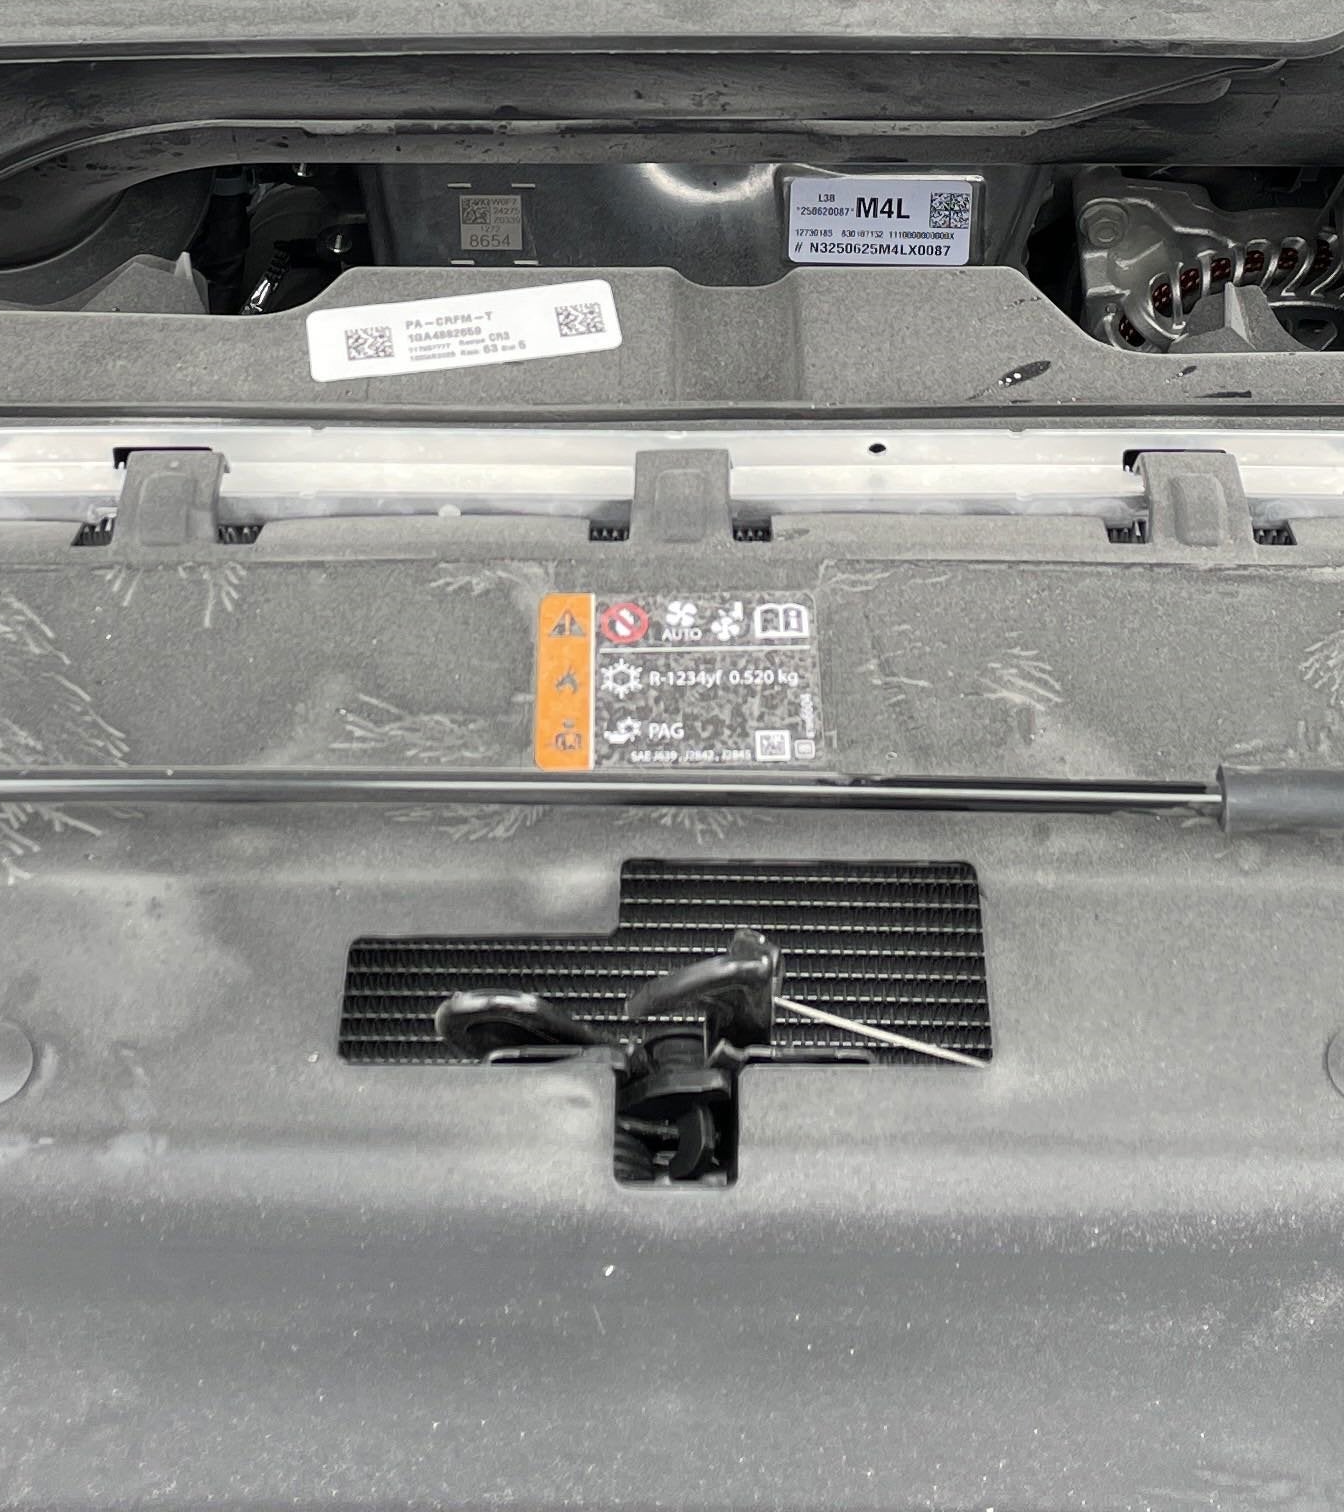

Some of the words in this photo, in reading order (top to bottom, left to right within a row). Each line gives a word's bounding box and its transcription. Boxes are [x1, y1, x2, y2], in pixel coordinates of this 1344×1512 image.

[856, 197, 910, 219] M4L
[470, 233, 511, 248] 8654
[662, 627, 702, 642] AUTO
[648, 670, 723, 688] R-1234yf
[729, 669, 774, 686] 0.520
[777, 668, 799, 687] kg
[648, 722, 685, 739] PAG
